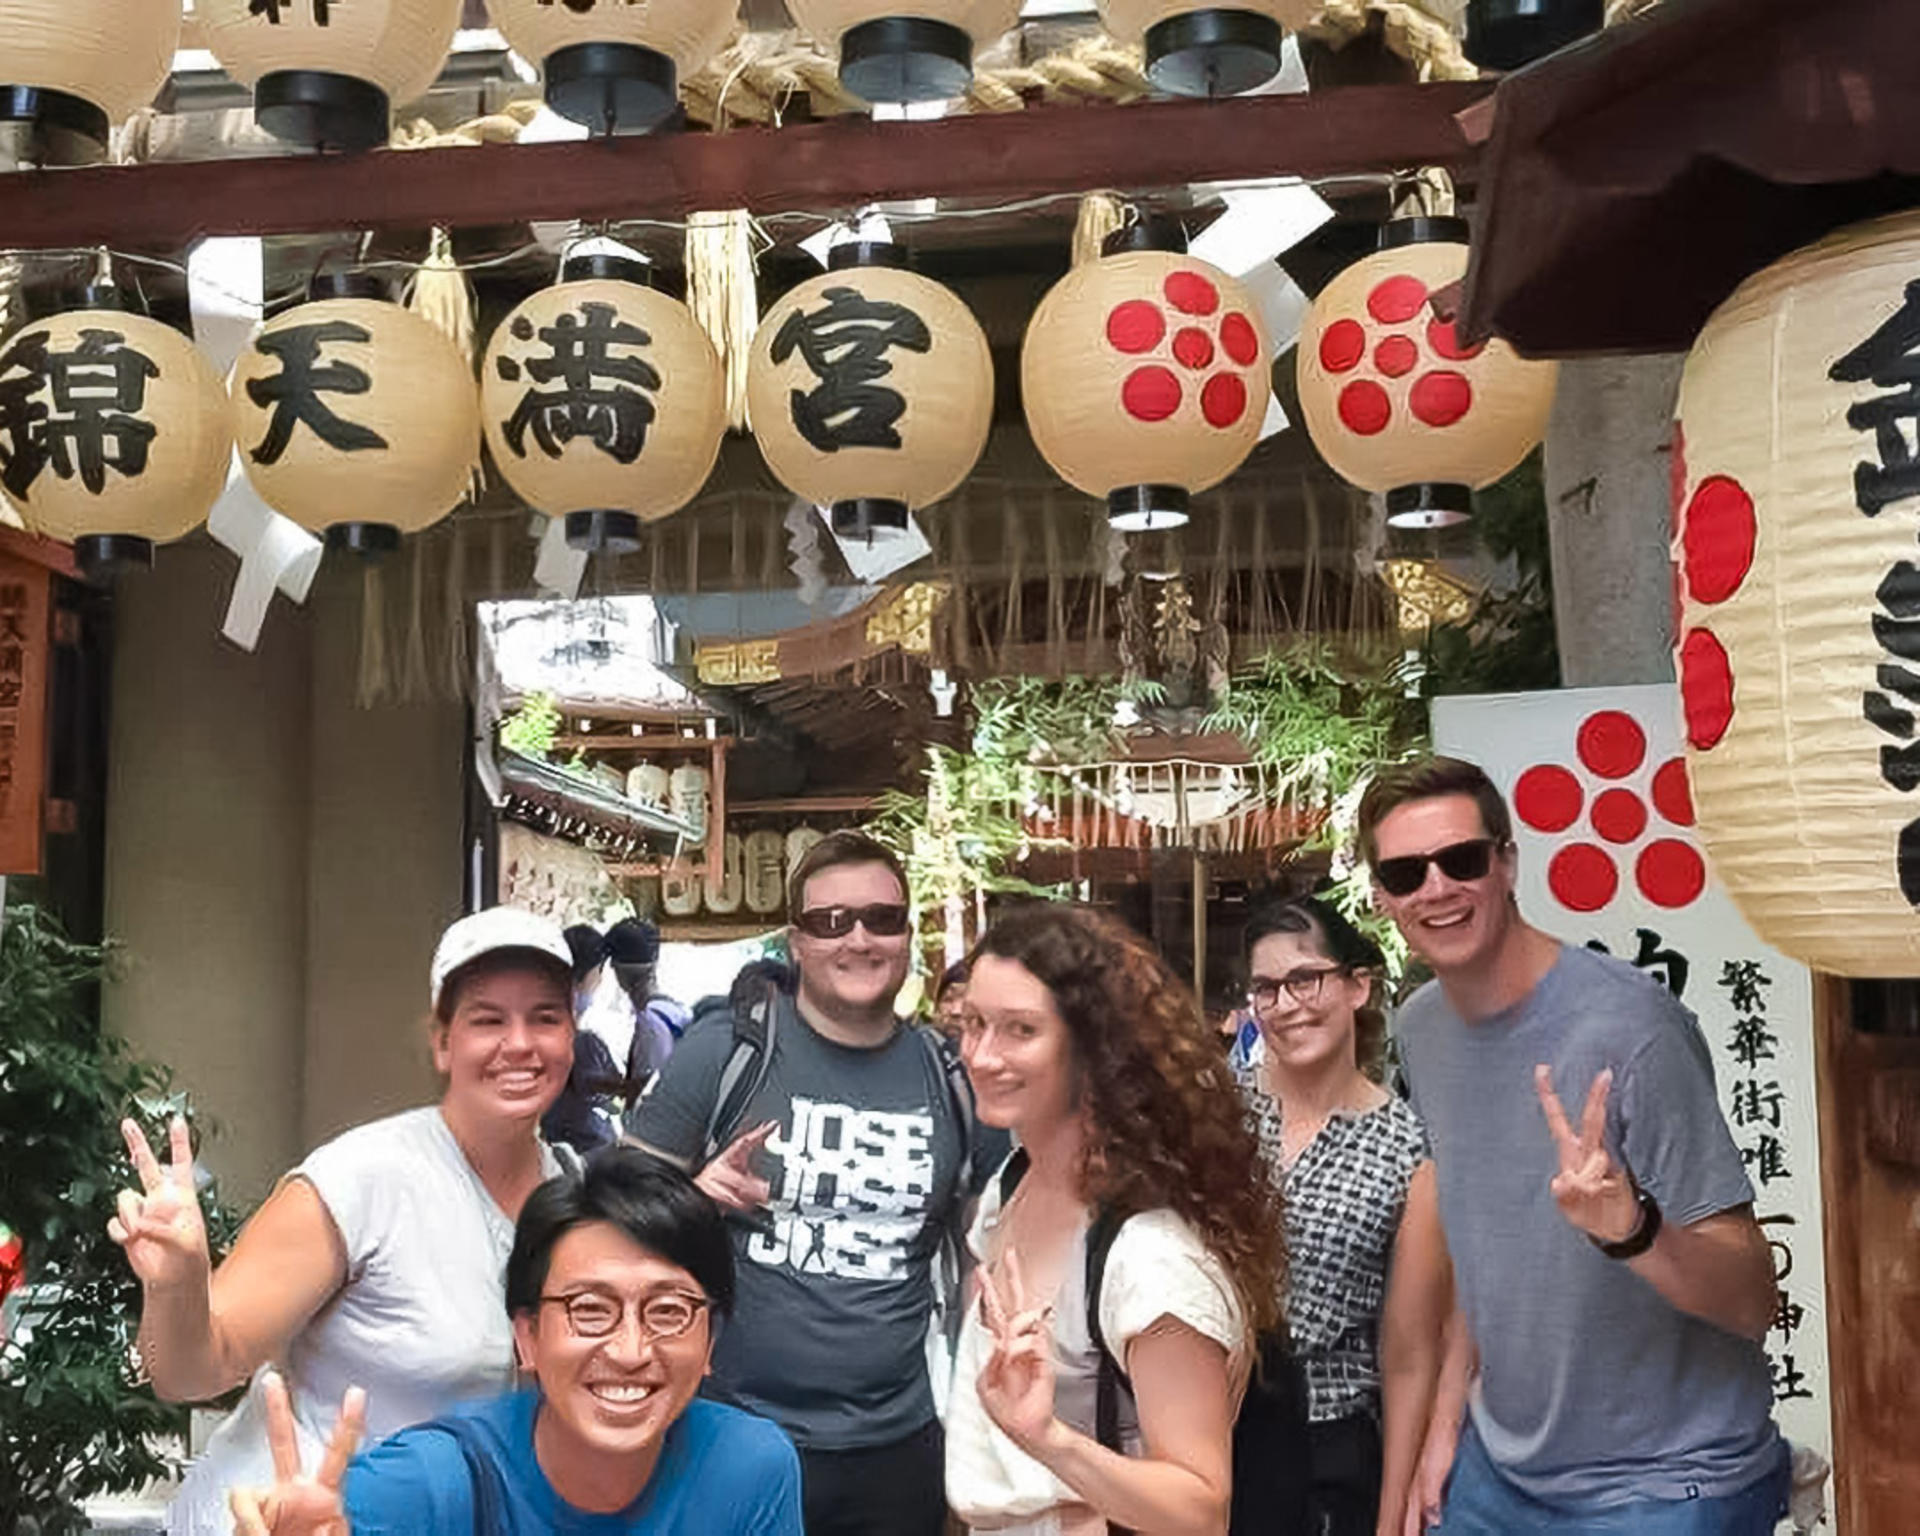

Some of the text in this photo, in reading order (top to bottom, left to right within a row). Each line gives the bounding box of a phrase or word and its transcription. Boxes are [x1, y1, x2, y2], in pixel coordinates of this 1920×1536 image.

[0, 286, 932, 502] 錦 天 満 宮
[764, 1096, 934, 1169] JOSE
[764, 1156, 934, 1222] JOSE
